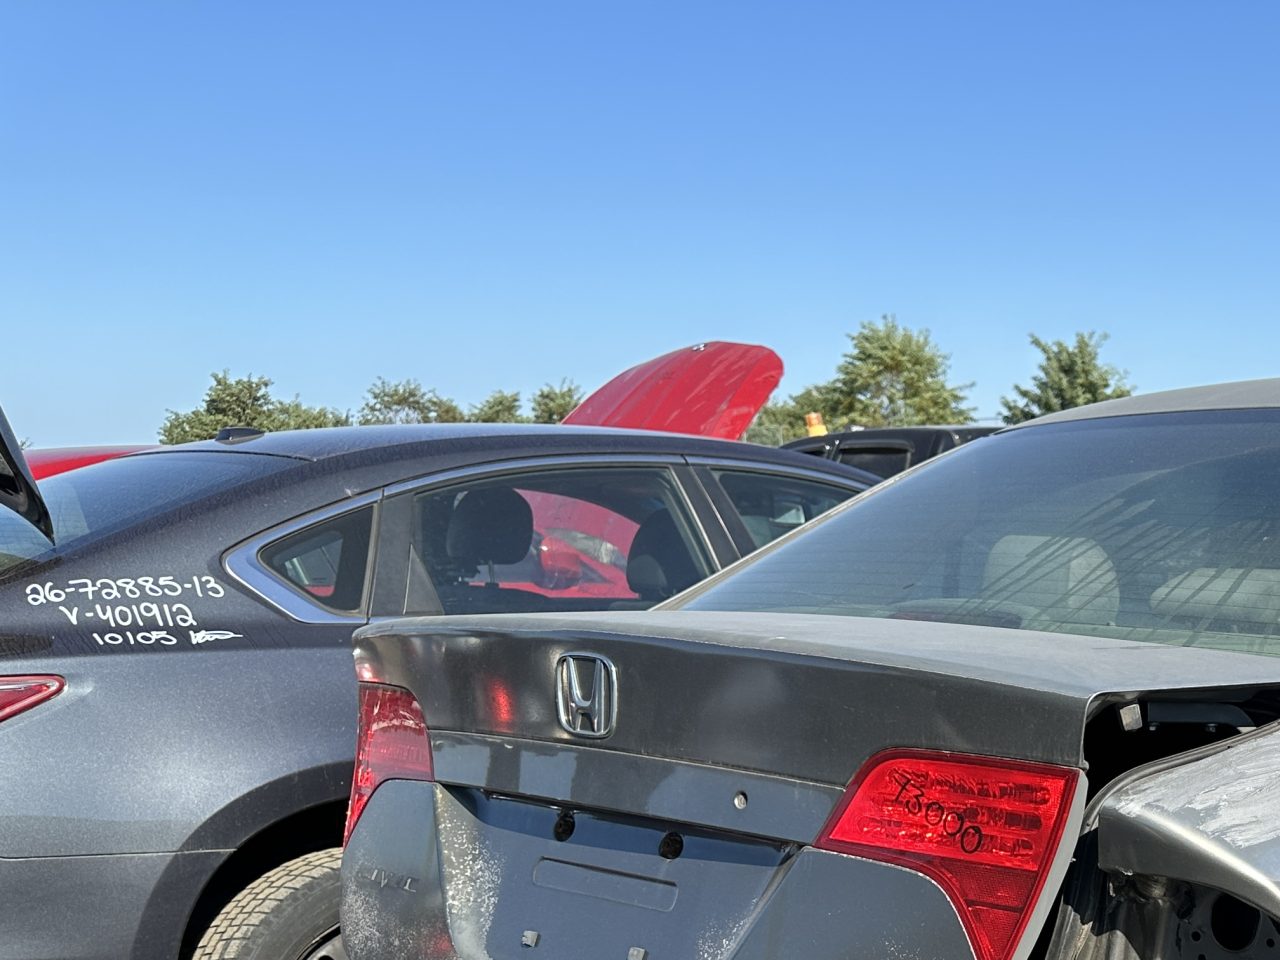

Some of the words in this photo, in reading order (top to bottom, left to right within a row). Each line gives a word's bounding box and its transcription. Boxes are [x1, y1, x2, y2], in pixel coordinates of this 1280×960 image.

[25, 575, 225, 606] 26-72885-13
[58, 602, 197, 627] V-401912
[891, 768, 984, 854] 73000
